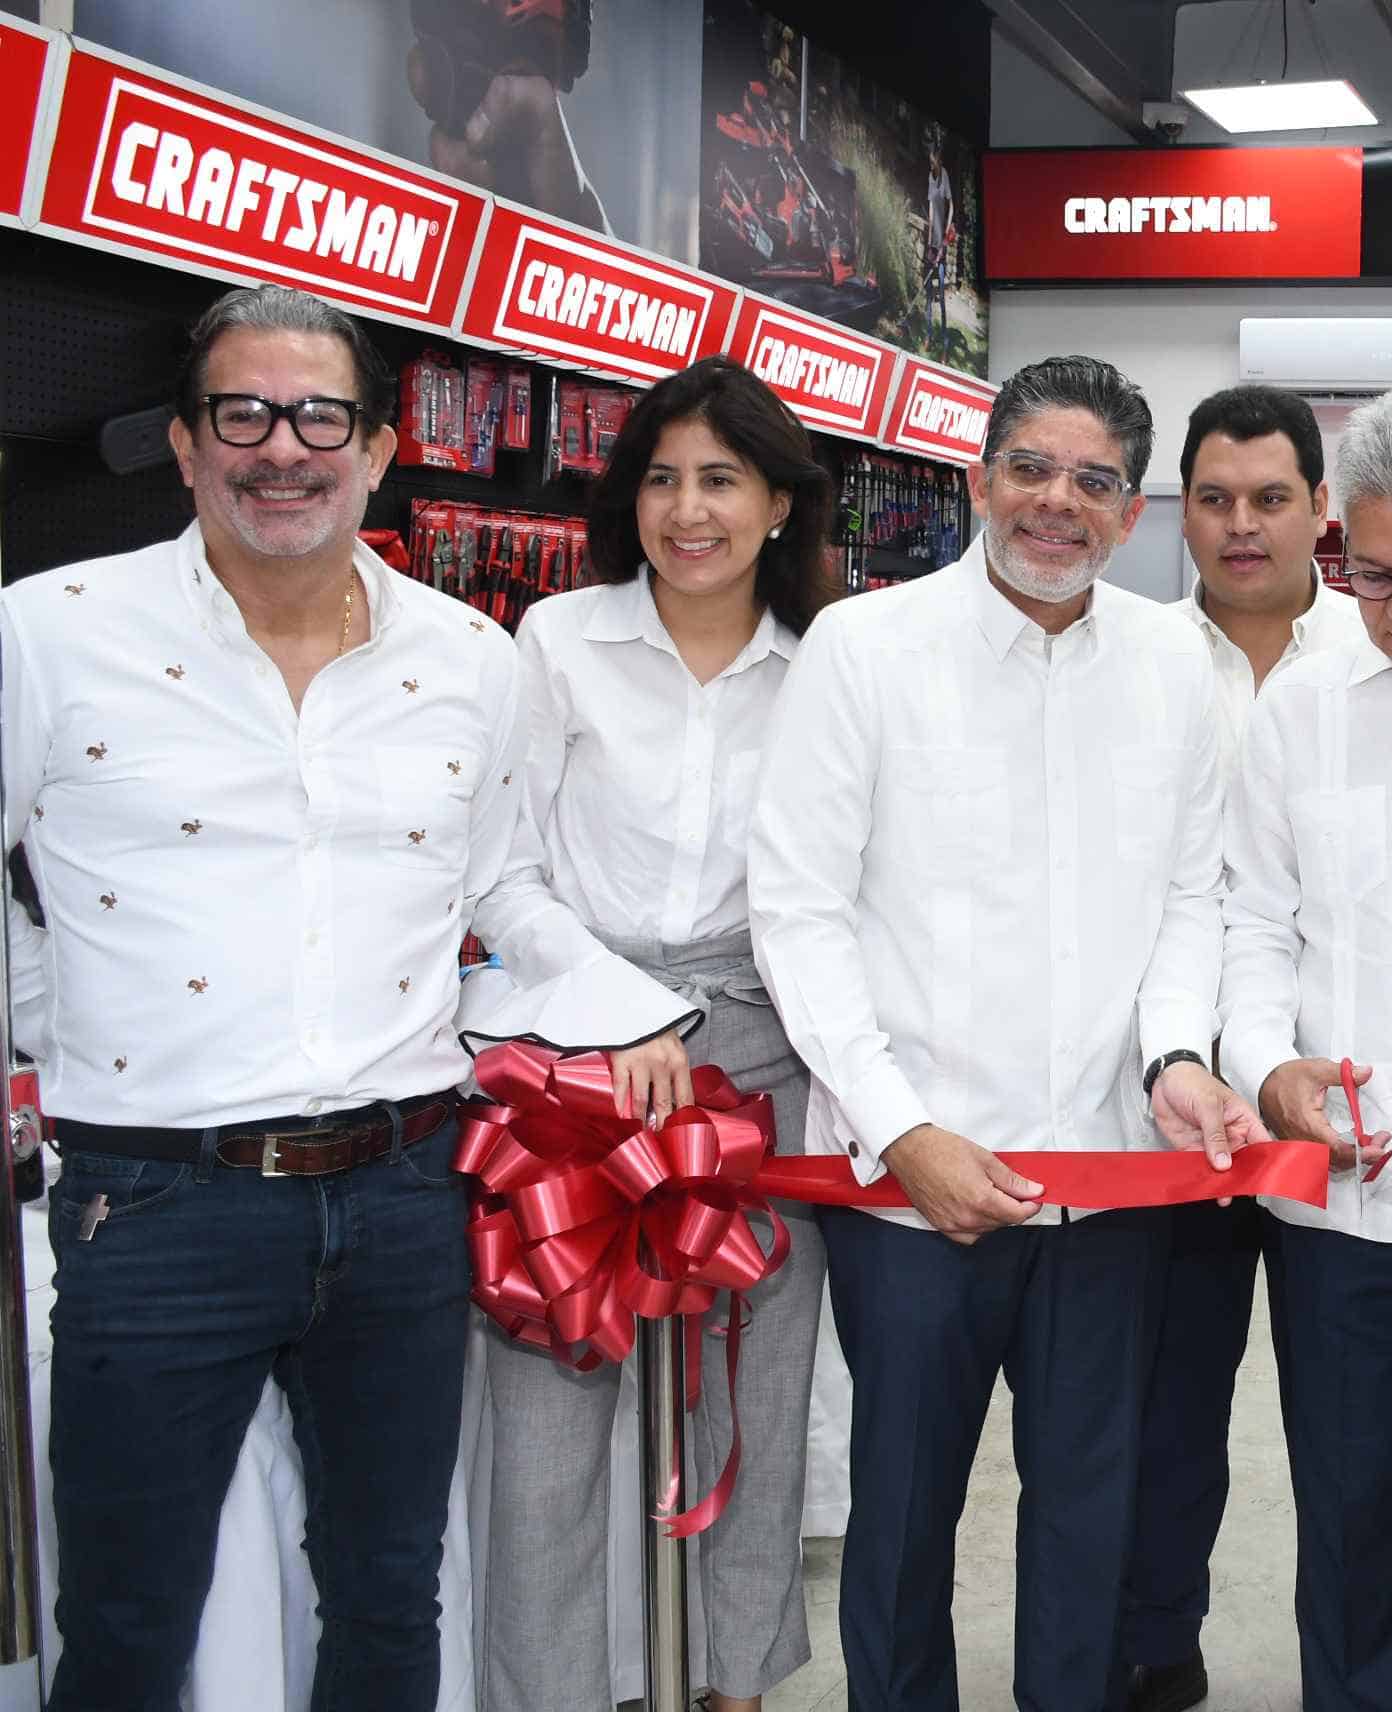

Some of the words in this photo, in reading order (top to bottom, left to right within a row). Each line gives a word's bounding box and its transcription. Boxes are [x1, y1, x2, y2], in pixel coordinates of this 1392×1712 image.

[518, 260, 696, 357] CRAFTSMAN
[753, 335, 870, 408] CRAFTSMAN
[908, 390, 990, 446] CRAFTSMAN
